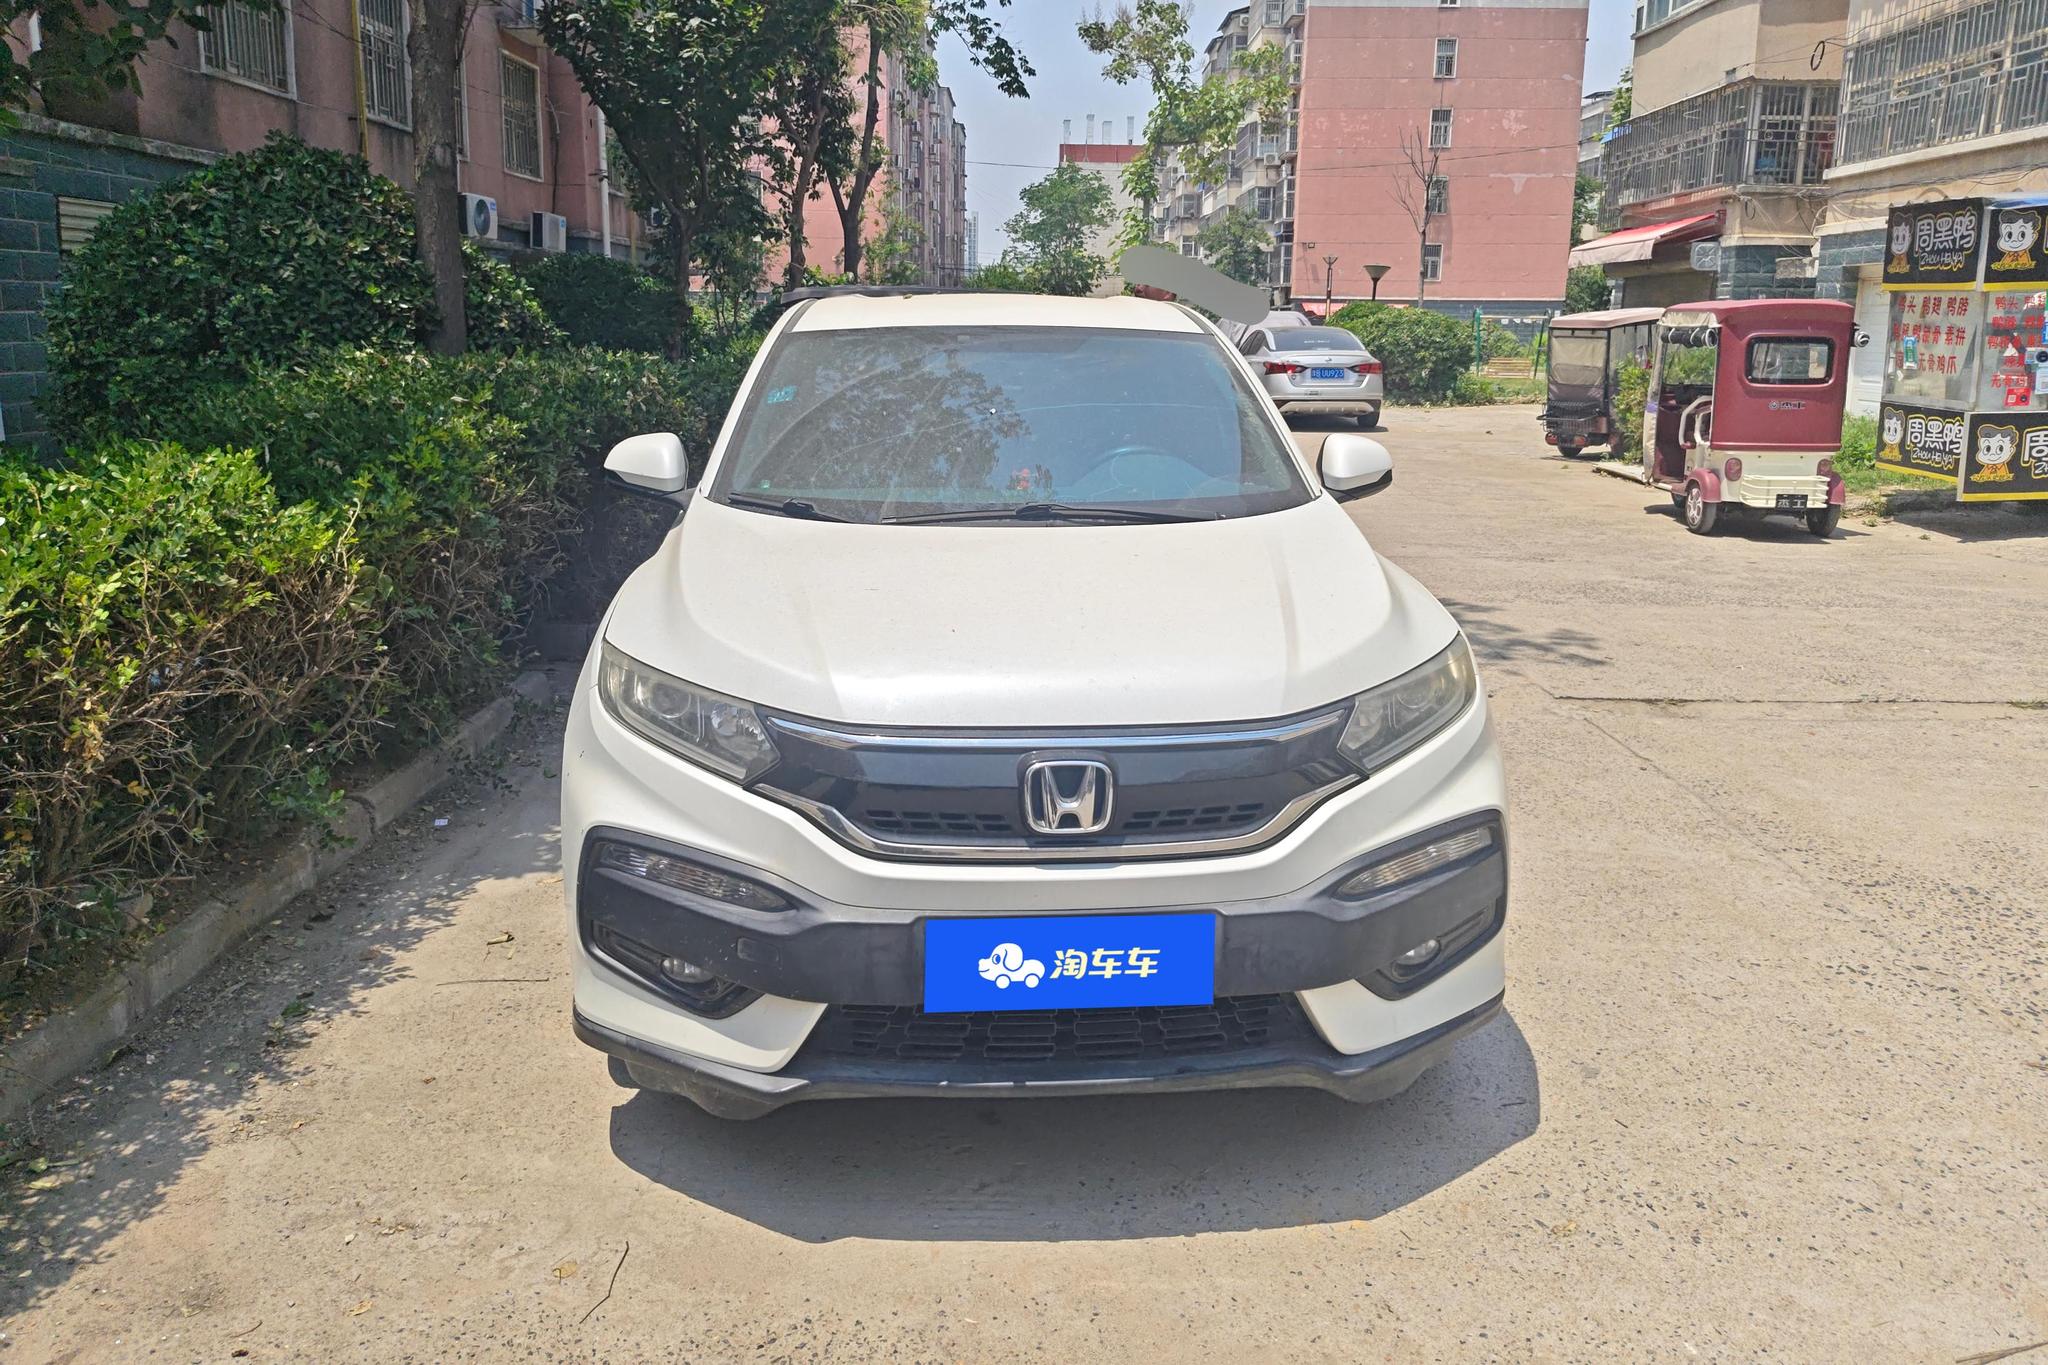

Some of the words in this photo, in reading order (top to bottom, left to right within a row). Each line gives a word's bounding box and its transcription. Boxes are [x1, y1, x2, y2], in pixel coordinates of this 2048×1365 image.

[1915, 211, 1976, 252] 周黑鸭
[1907, 418, 1963, 452] 周黑鸭
